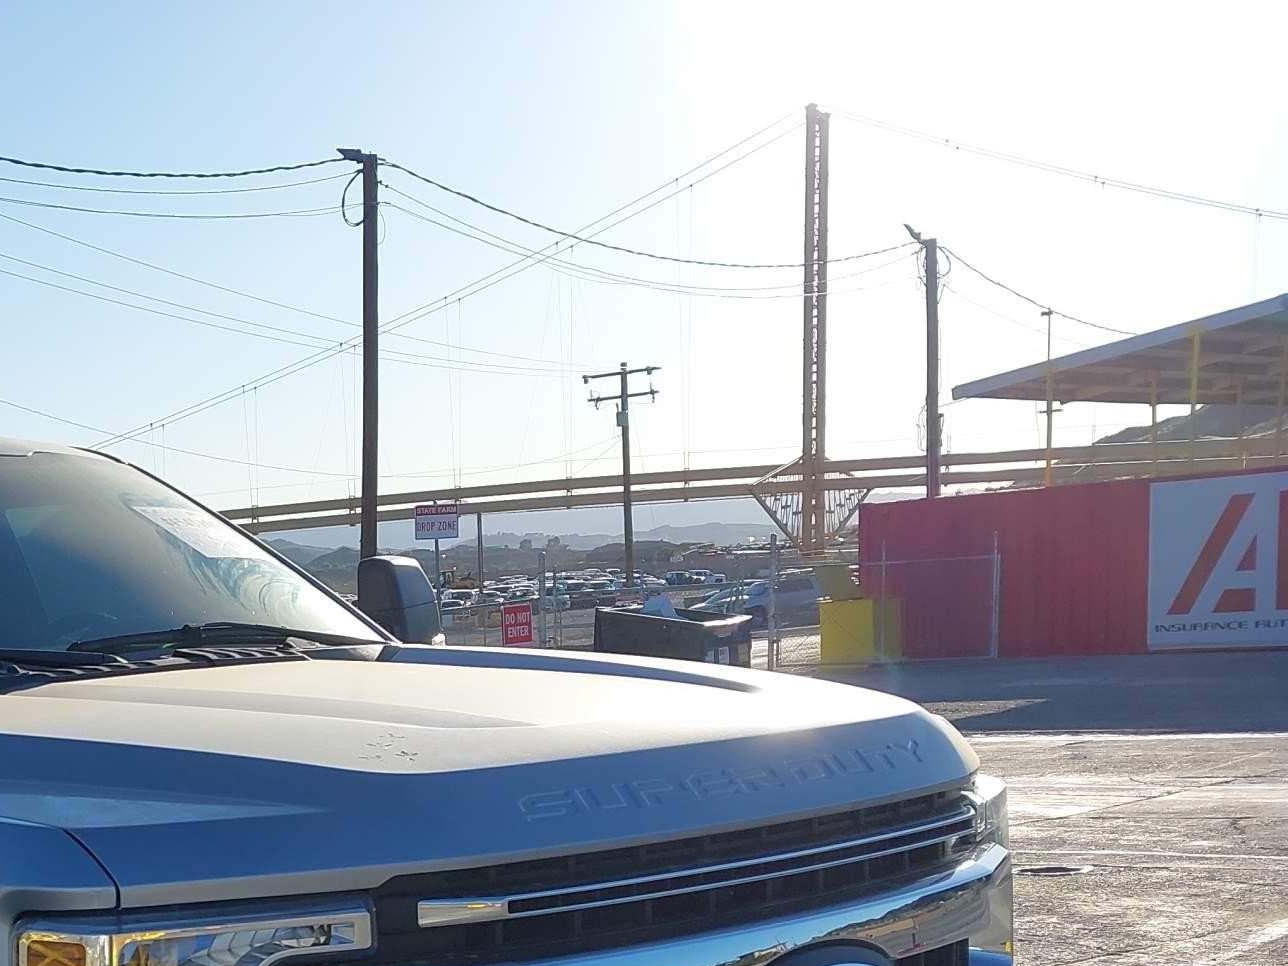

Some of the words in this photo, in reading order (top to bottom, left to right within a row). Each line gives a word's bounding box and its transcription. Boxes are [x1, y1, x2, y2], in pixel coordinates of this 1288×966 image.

[417, 507, 436, 515] STATE
[438, 505, 457, 513] FARM
[417, 521, 435, 533] DROP
[438, 520, 457, 531] ZONE
[505, 613, 515, 625] DO
[517, 612, 531, 624] NOT
[508, 625, 529, 638] ENTER
[1155, 620, 1249, 632] INSURANCE
[518, 766, 785, 821] SUPER
[784, 738, 924, 785] DUTY
